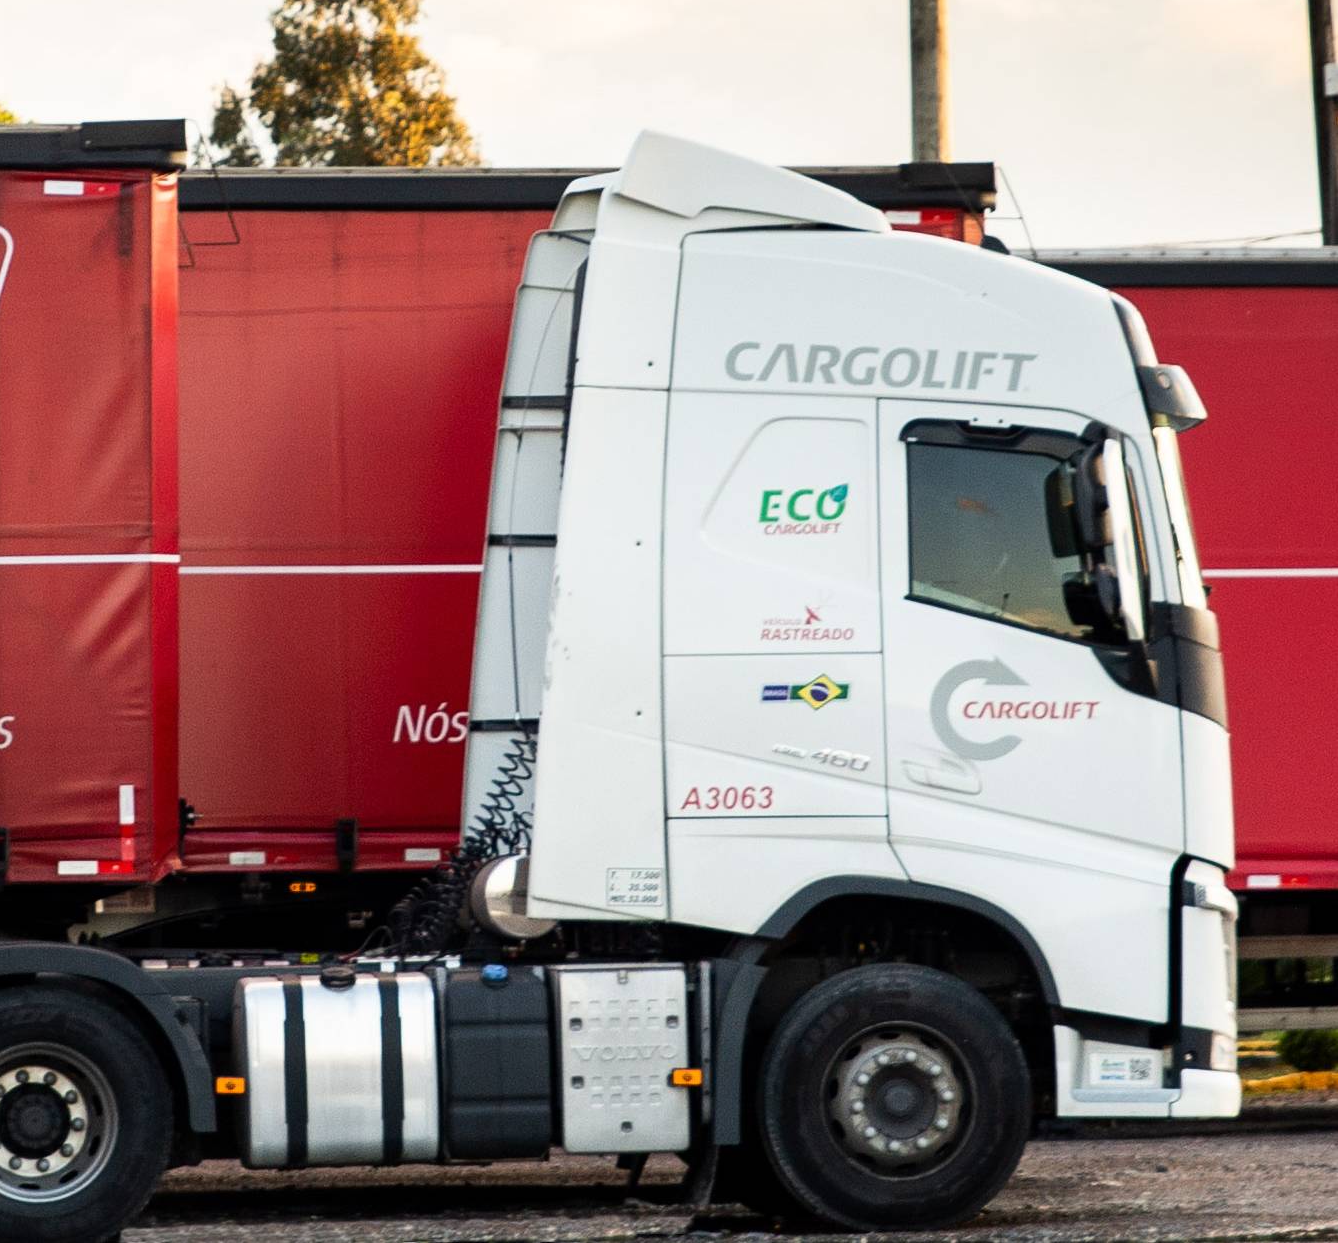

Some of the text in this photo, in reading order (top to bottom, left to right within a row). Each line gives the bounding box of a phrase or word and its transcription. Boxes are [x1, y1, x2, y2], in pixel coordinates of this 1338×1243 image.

[724, 341, 1038, 392] CARGOLIFT
[759, 483, 848, 522] ECO
[764, 522, 842, 535] CARGOLIFT
[760, 627, 855, 641] RASTREADO
[962, 700, 1100, 721] CARGOLIFT
[810, 747, 871, 772] 460
[680, 786, 774, 811] A3063
